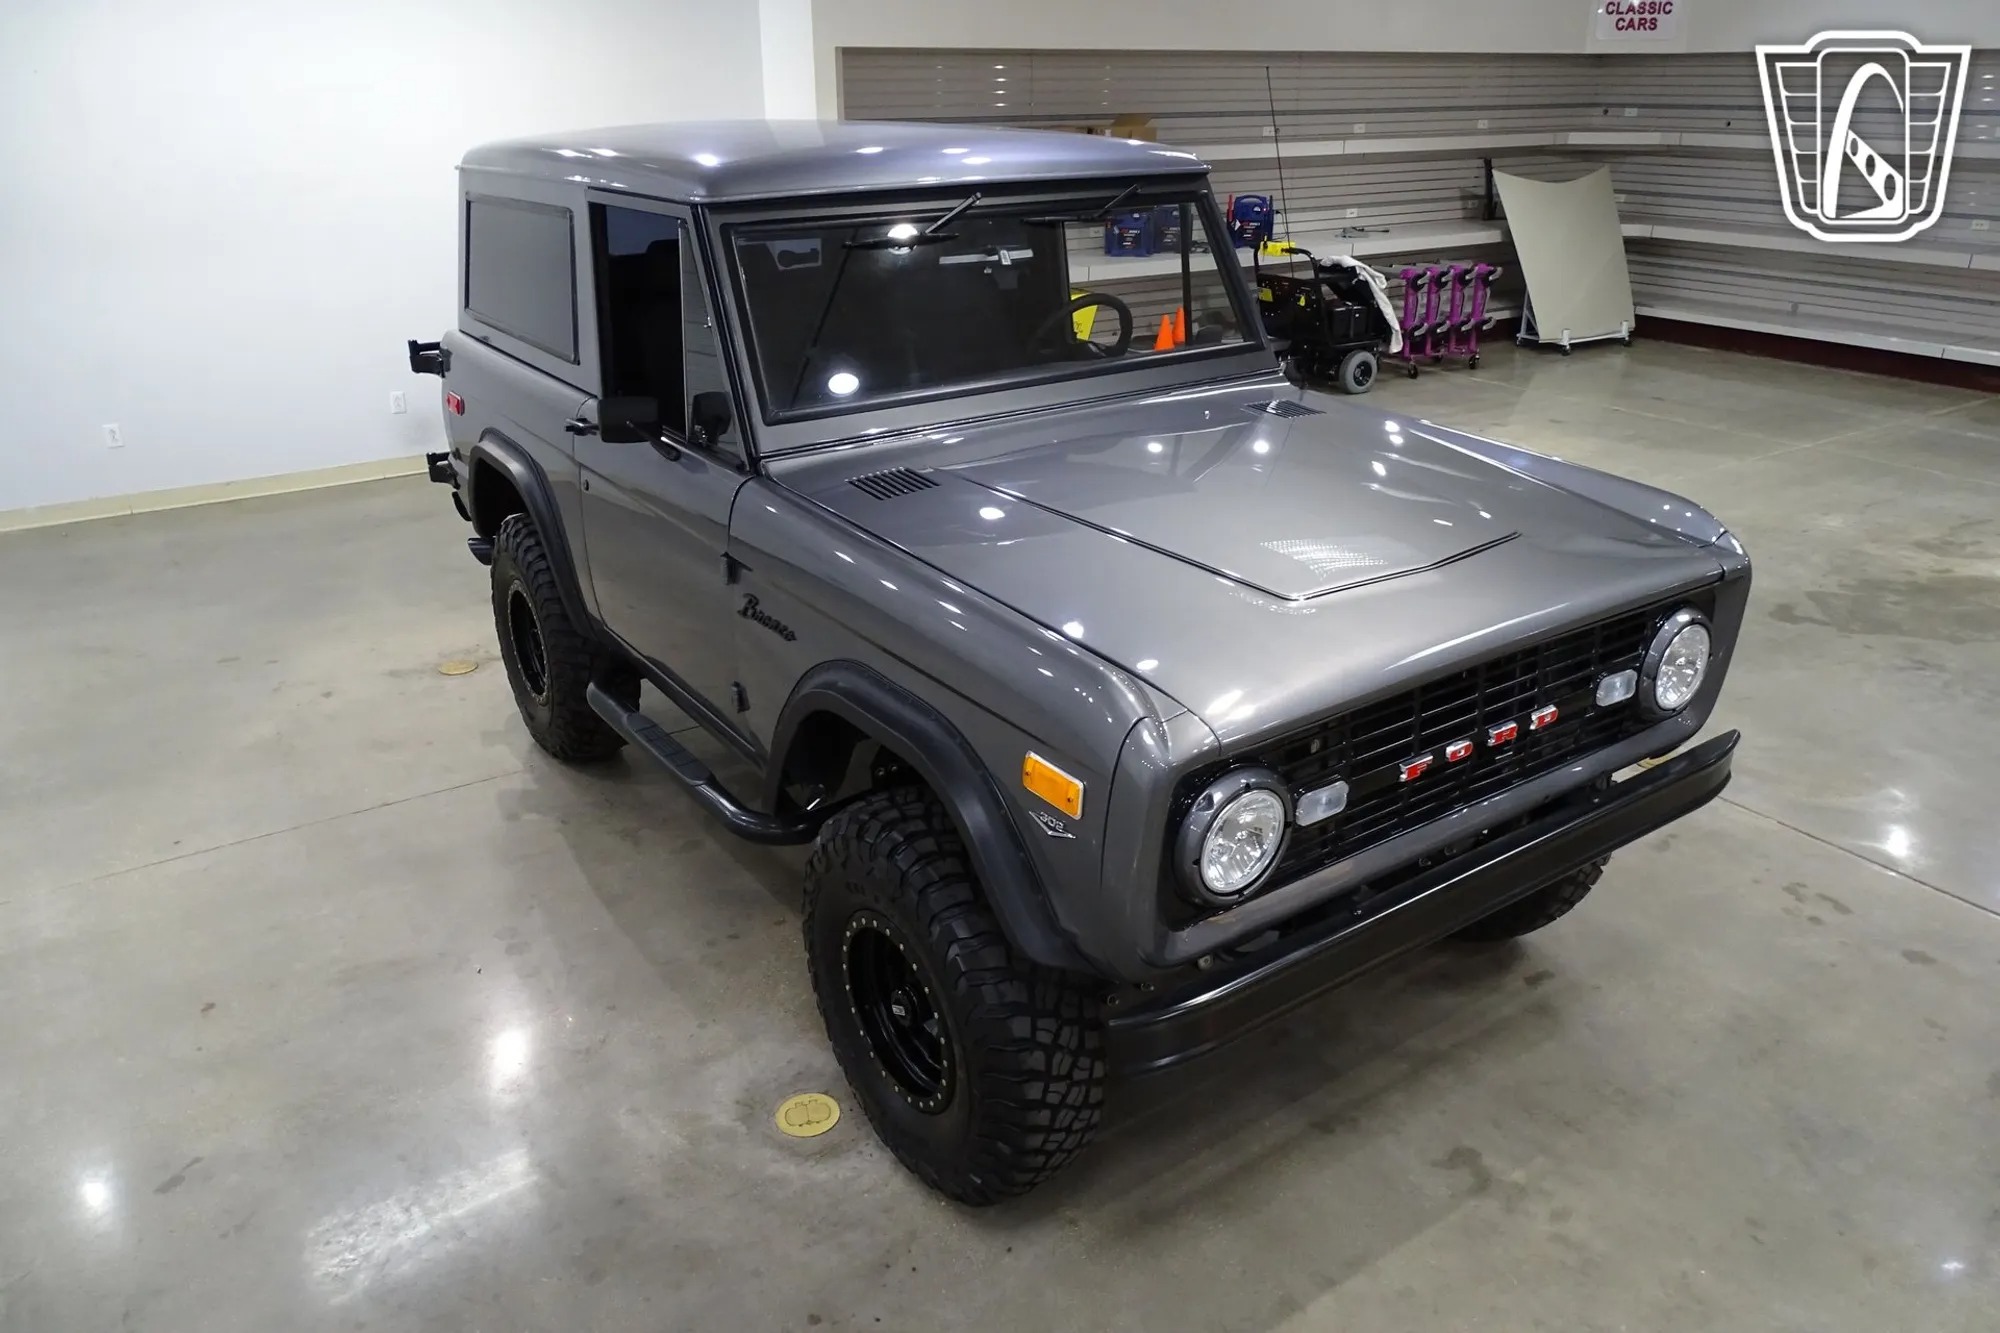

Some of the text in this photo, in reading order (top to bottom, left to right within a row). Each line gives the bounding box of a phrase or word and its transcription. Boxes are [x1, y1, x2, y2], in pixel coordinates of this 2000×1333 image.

[1605, 1, 1674, 15] CLASSIC
[1615, 17, 1658, 31] CARS
[737, 592, 797, 641] Bronco
[1400, 704, 1558, 782] FORD
[1039, 812, 1064, 832] 302
